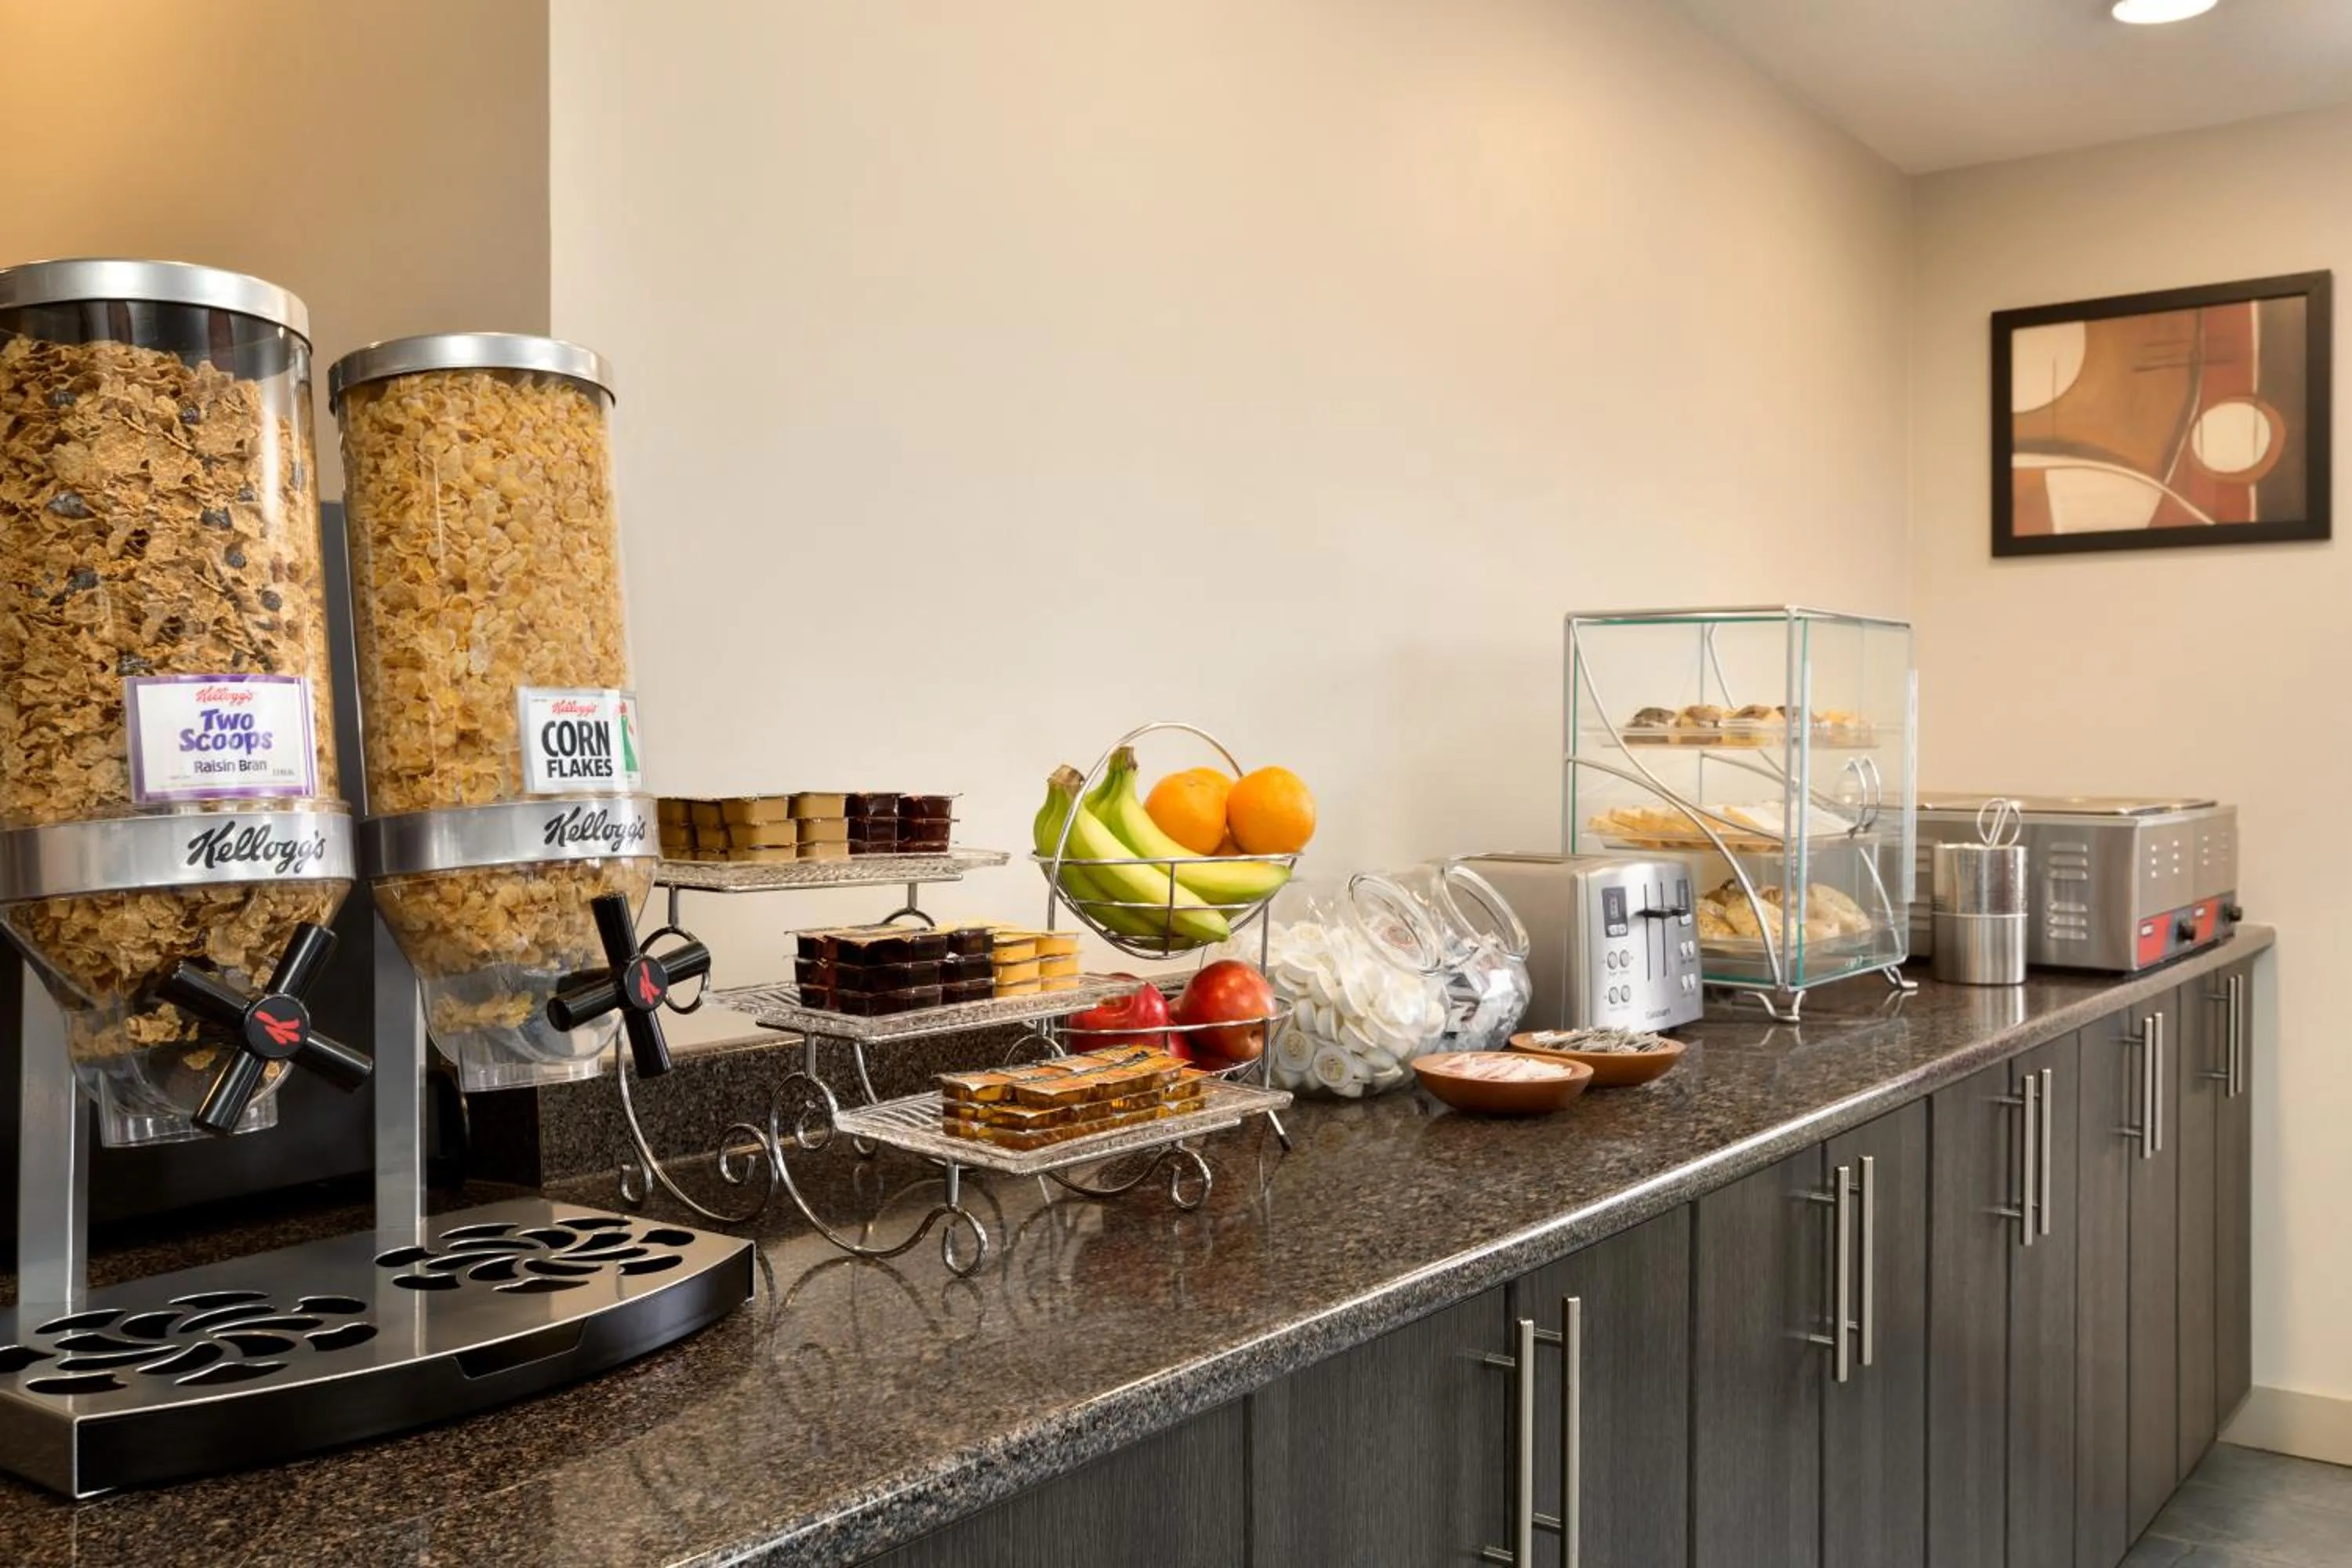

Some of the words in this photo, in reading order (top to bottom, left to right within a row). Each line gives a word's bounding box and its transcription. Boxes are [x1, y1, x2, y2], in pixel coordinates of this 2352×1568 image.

[196, 686, 252, 705] Kellogg's
[201, 709, 255, 731] Two
[180, 729, 273, 753] Scoops
[542, 720, 611, 757] CORN
[194, 761, 235, 773] Raisin
[239, 760, 267, 771] Bran
[546, 758, 613, 778] FLAKES
[544, 807, 646, 852] Kellogg's
[187, 820, 326, 874] Kellogg's
